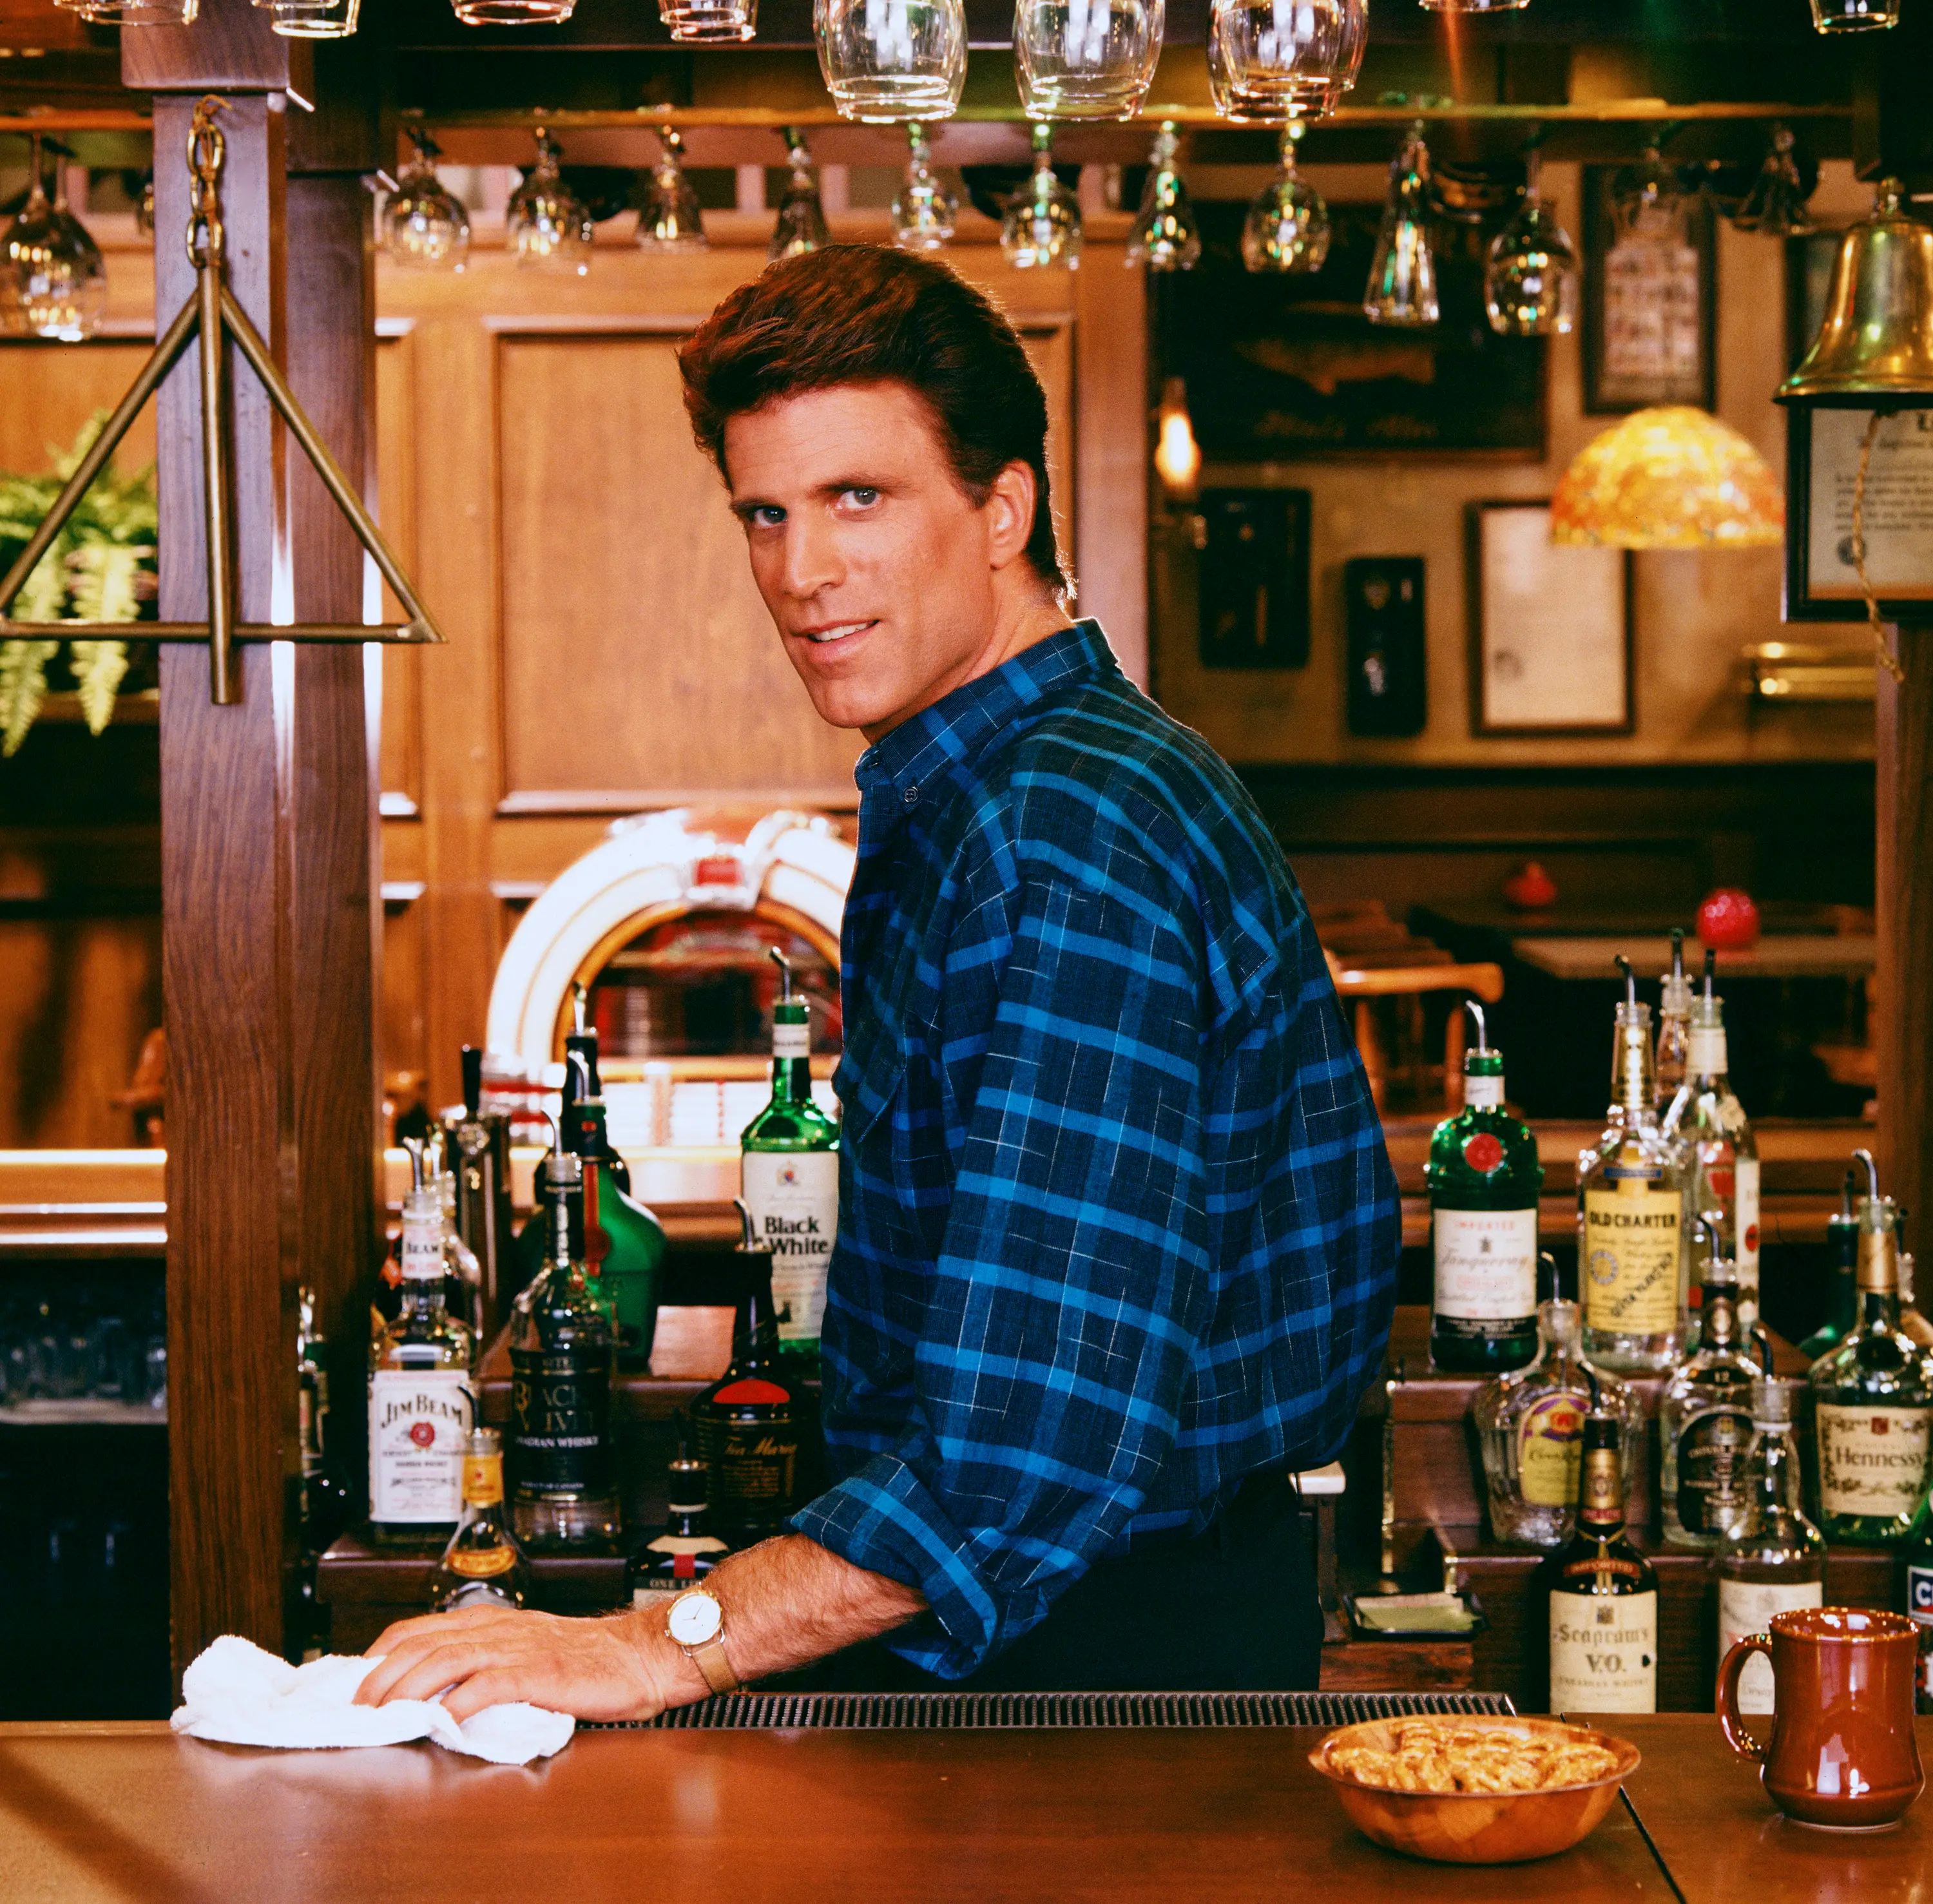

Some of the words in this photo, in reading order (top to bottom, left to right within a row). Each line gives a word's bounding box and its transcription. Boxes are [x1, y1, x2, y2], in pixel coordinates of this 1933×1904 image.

[765, 1216, 819, 1234] Black
[1590, 1212, 1611, 1227] OLD
[1614, 1214, 1676, 1228] CHARTER
[771, 1238, 829, 1255] White
[381, 1399, 412, 1428] JIM
[416, 1394, 463, 1427] BEAM
[1836, 1446, 1923, 1471] Hennessy
[1557, 1622, 1648, 1645] Seagram's
[1585, 1653, 1627, 1673] V.O.
